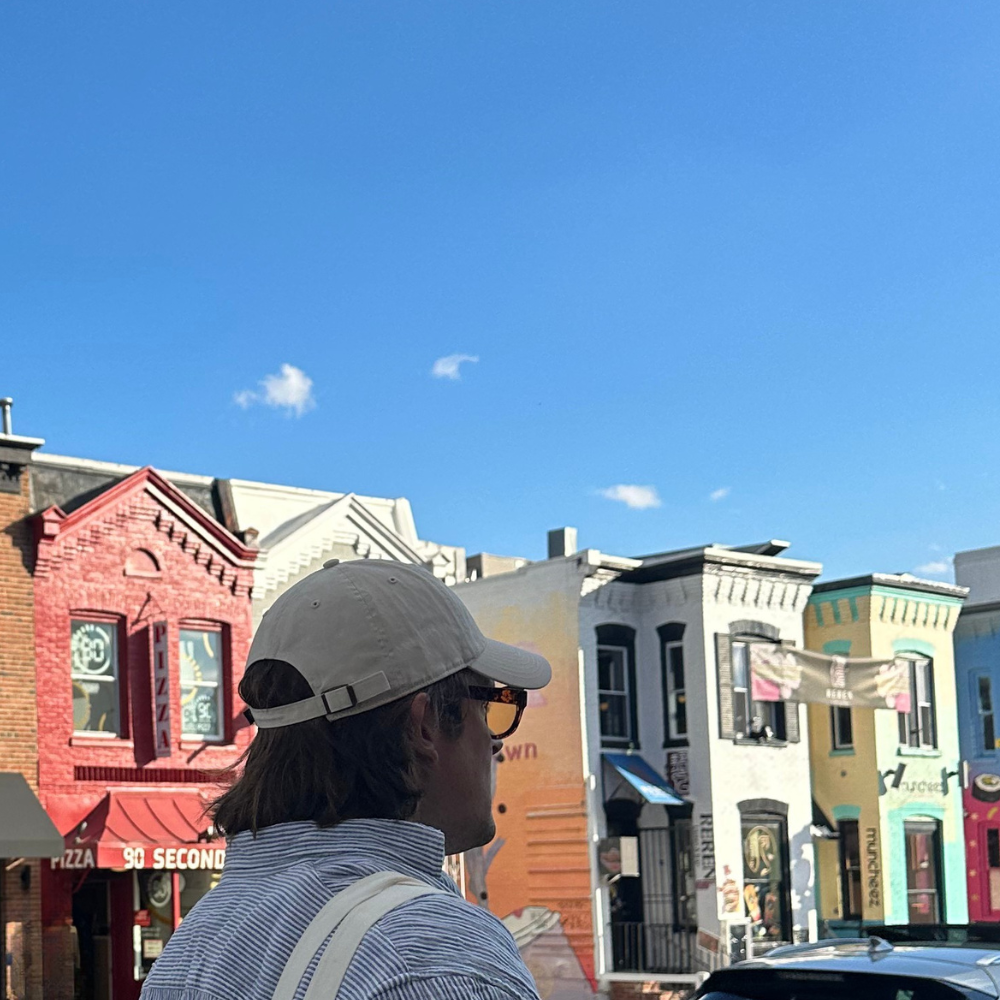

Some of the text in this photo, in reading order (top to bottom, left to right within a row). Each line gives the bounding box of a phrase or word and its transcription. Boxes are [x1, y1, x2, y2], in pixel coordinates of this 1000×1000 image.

[154, 624, 170, 749] PIZZA
[122, 847, 226, 869] 90 SECOND
[700, 814, 716, 879] REREN
[865, 827, 882, 908] muncheez
